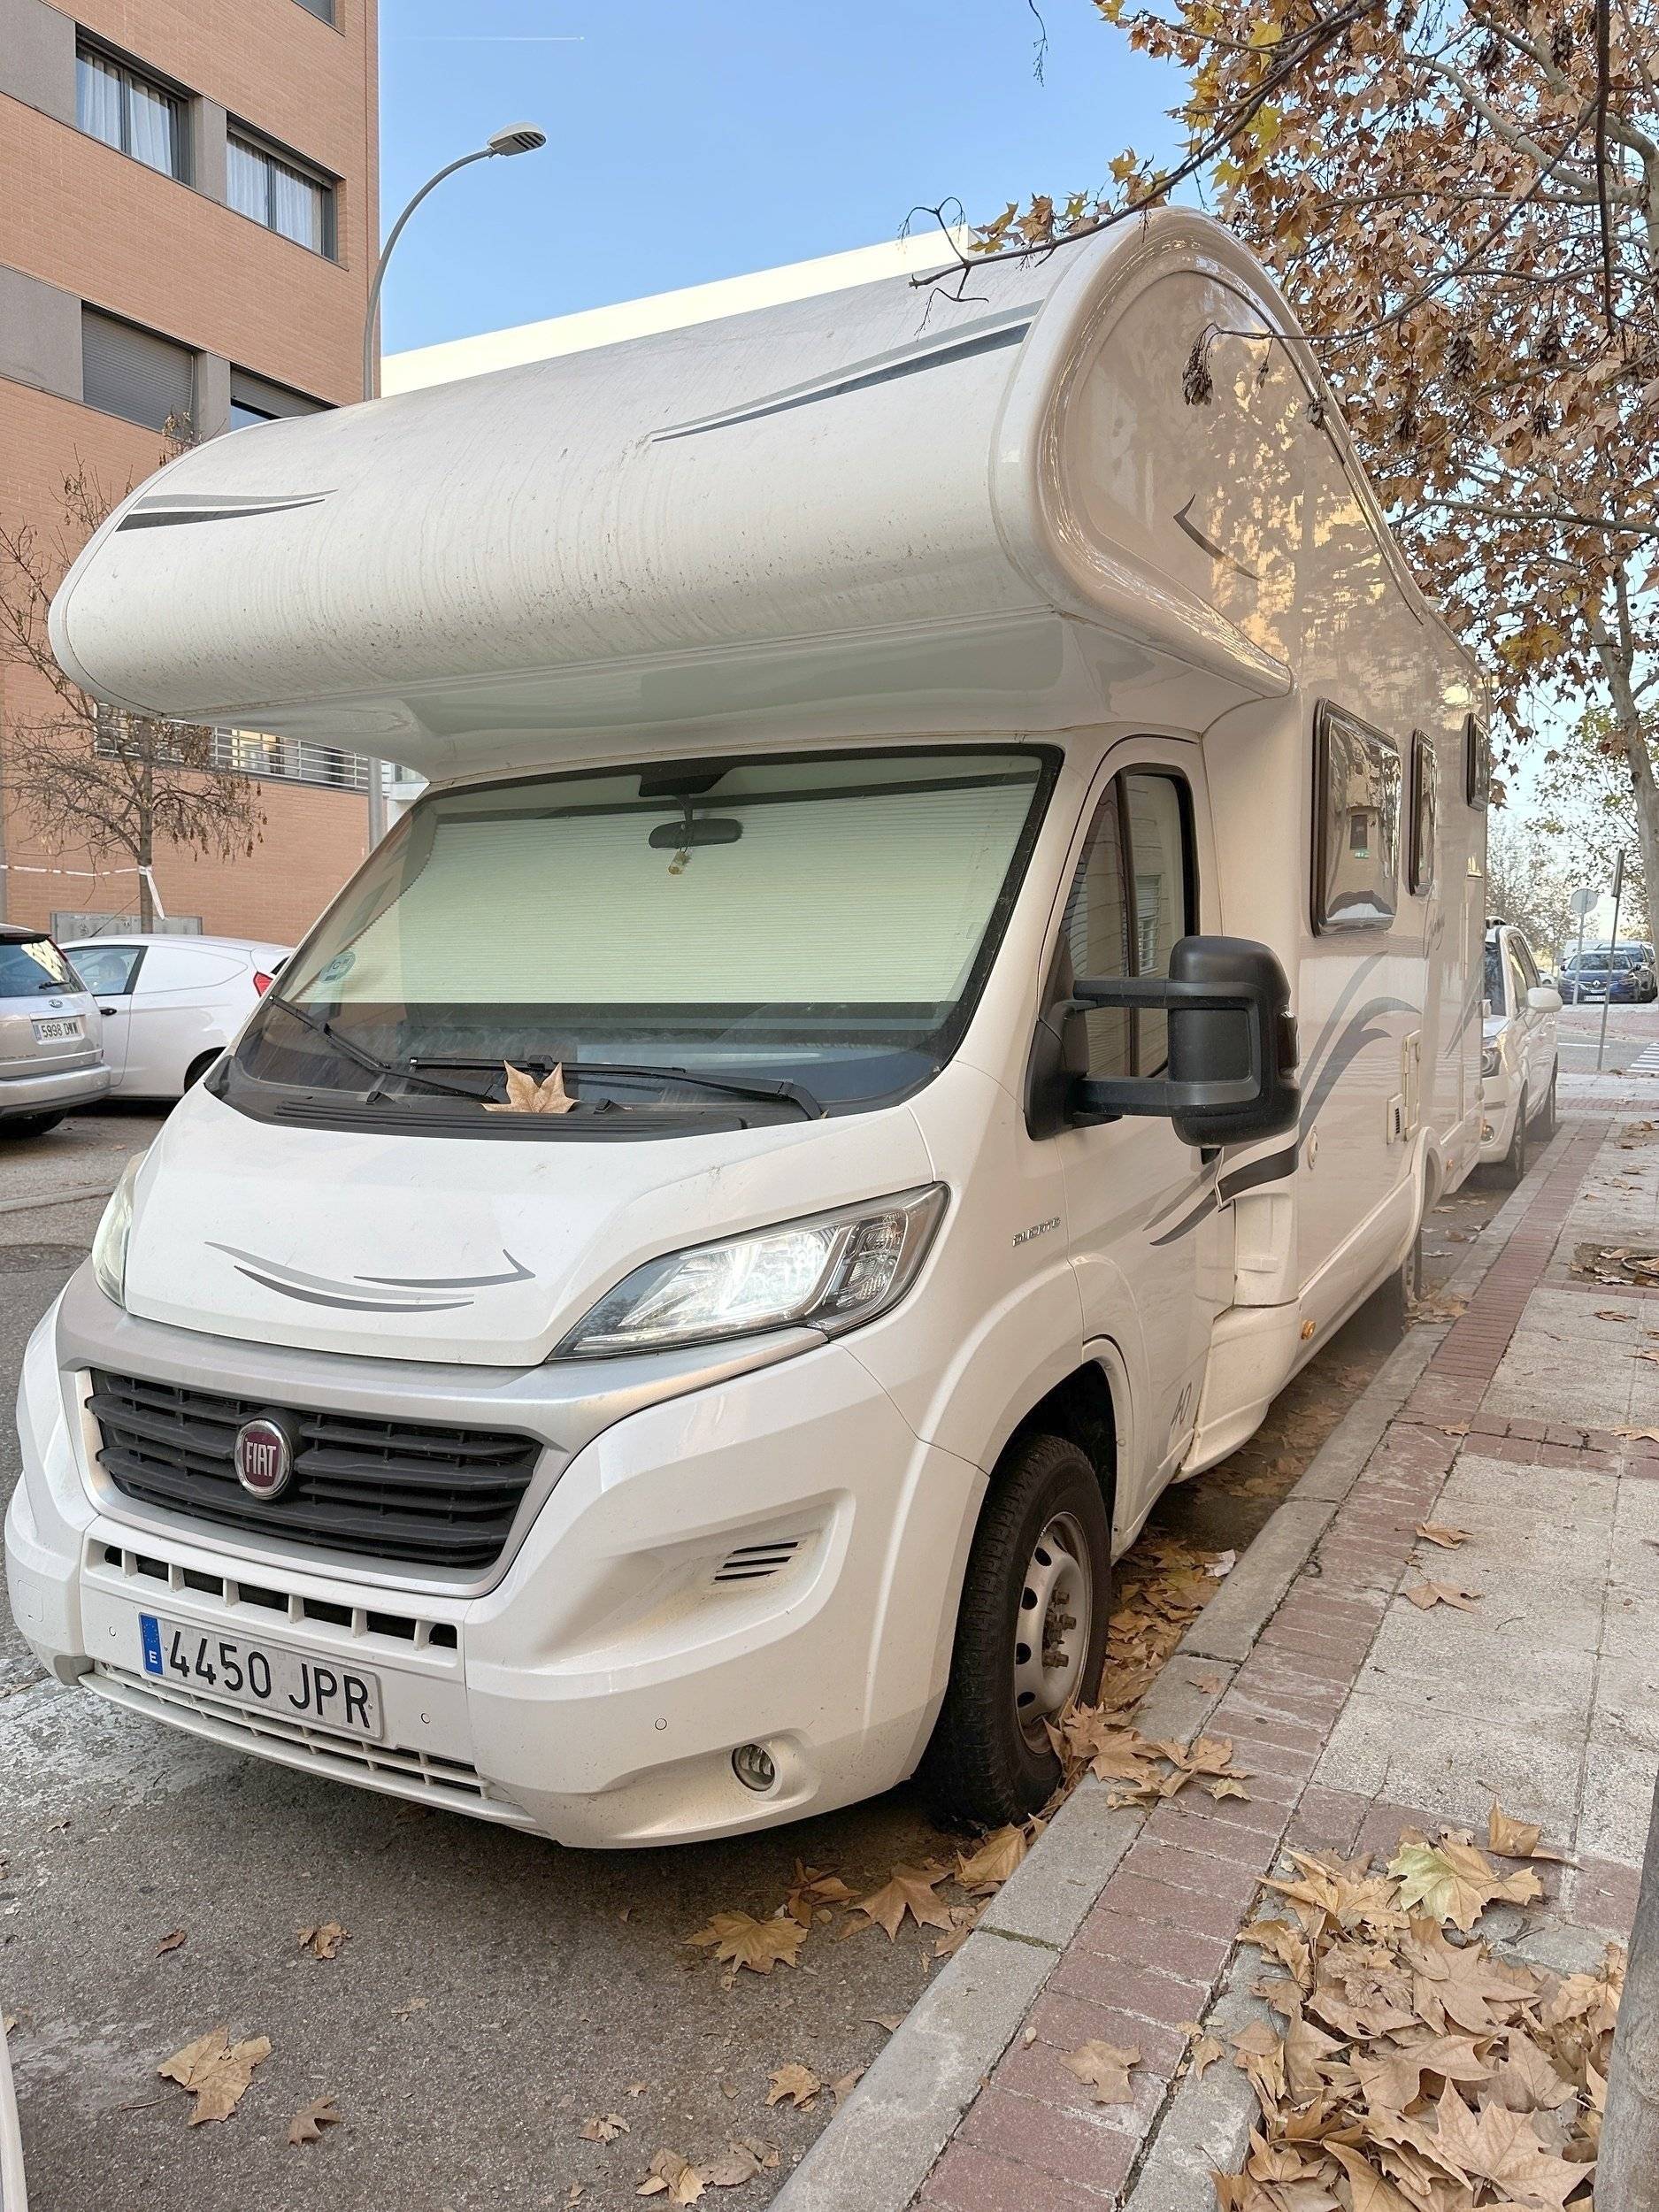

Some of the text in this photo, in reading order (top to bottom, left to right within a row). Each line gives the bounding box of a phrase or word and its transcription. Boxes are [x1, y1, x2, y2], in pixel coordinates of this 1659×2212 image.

[41, 1023, 63, 1038] 5998
[246, 1441, 277, 1477] FIAT
[149, 1649, 158, 1664] E
[169, 1631, 371, 1729] 4450 JPR
